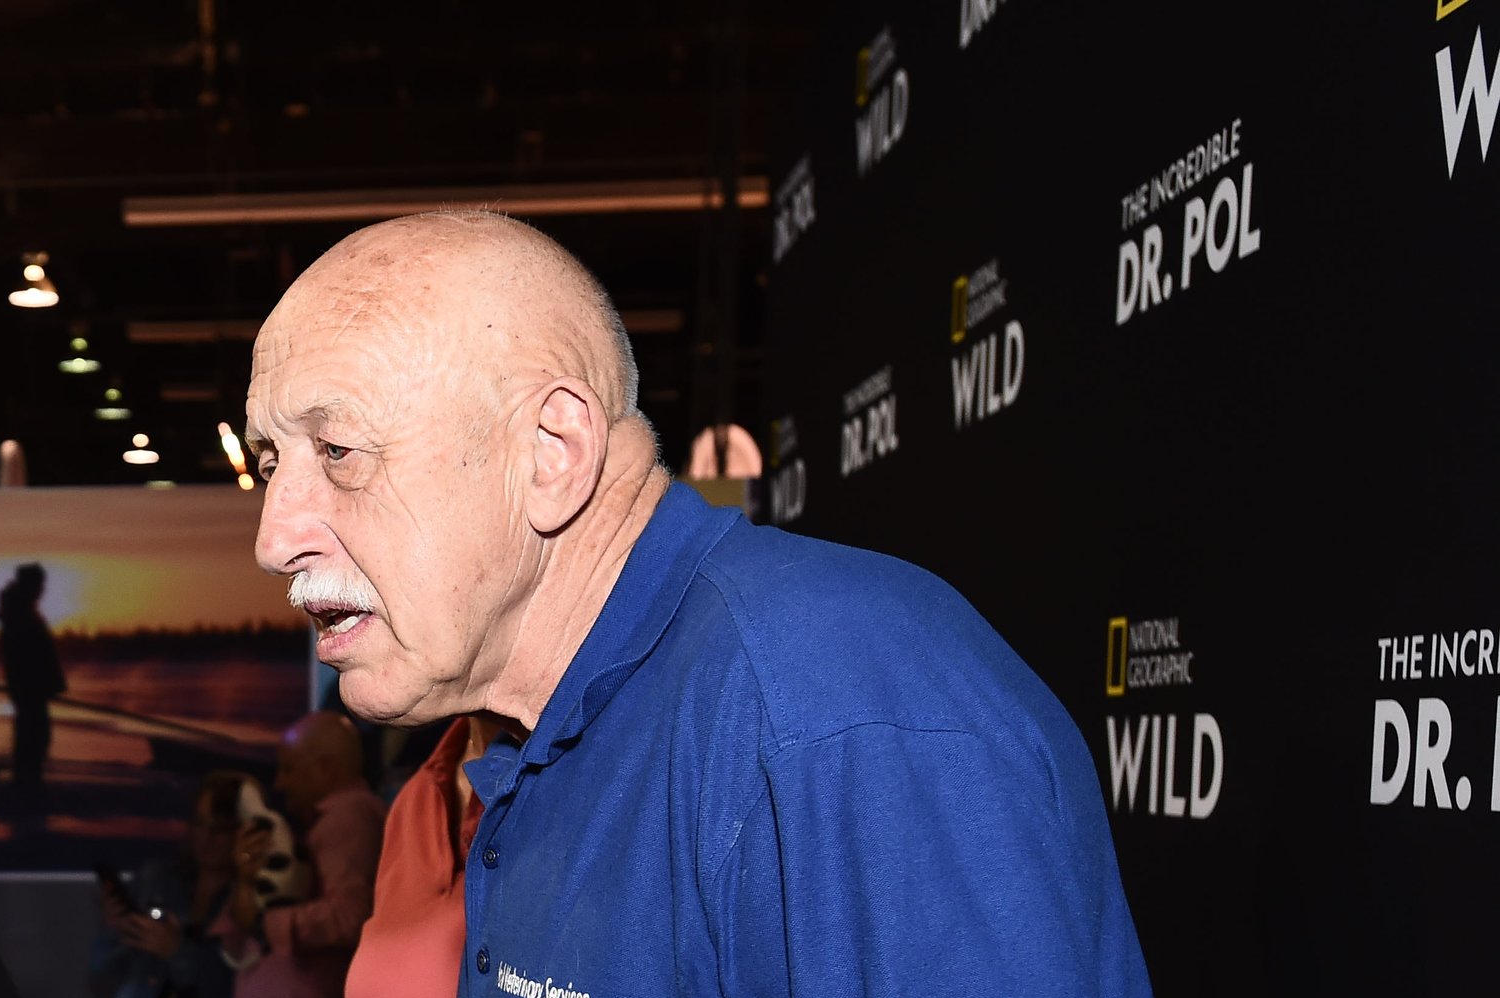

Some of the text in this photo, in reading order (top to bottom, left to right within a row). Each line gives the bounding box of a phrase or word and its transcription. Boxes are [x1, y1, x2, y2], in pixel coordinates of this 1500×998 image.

[1121, 117, 1242, 231] THE INCREDIBLE
[1115, 223, 1174, 327] DR.
[1180, 160, 1261, 290] POL
[866, 393, 899, 459] POL
[952, 320, 1025, 431] WILD
[1126, 650, 1194, 688] GEOGRAPHIC
[1377, 628, 1500, 682] THE INCR
[1105, 712, 1225, 820] WILD
[1369, 697, 1472, 812] DR.
